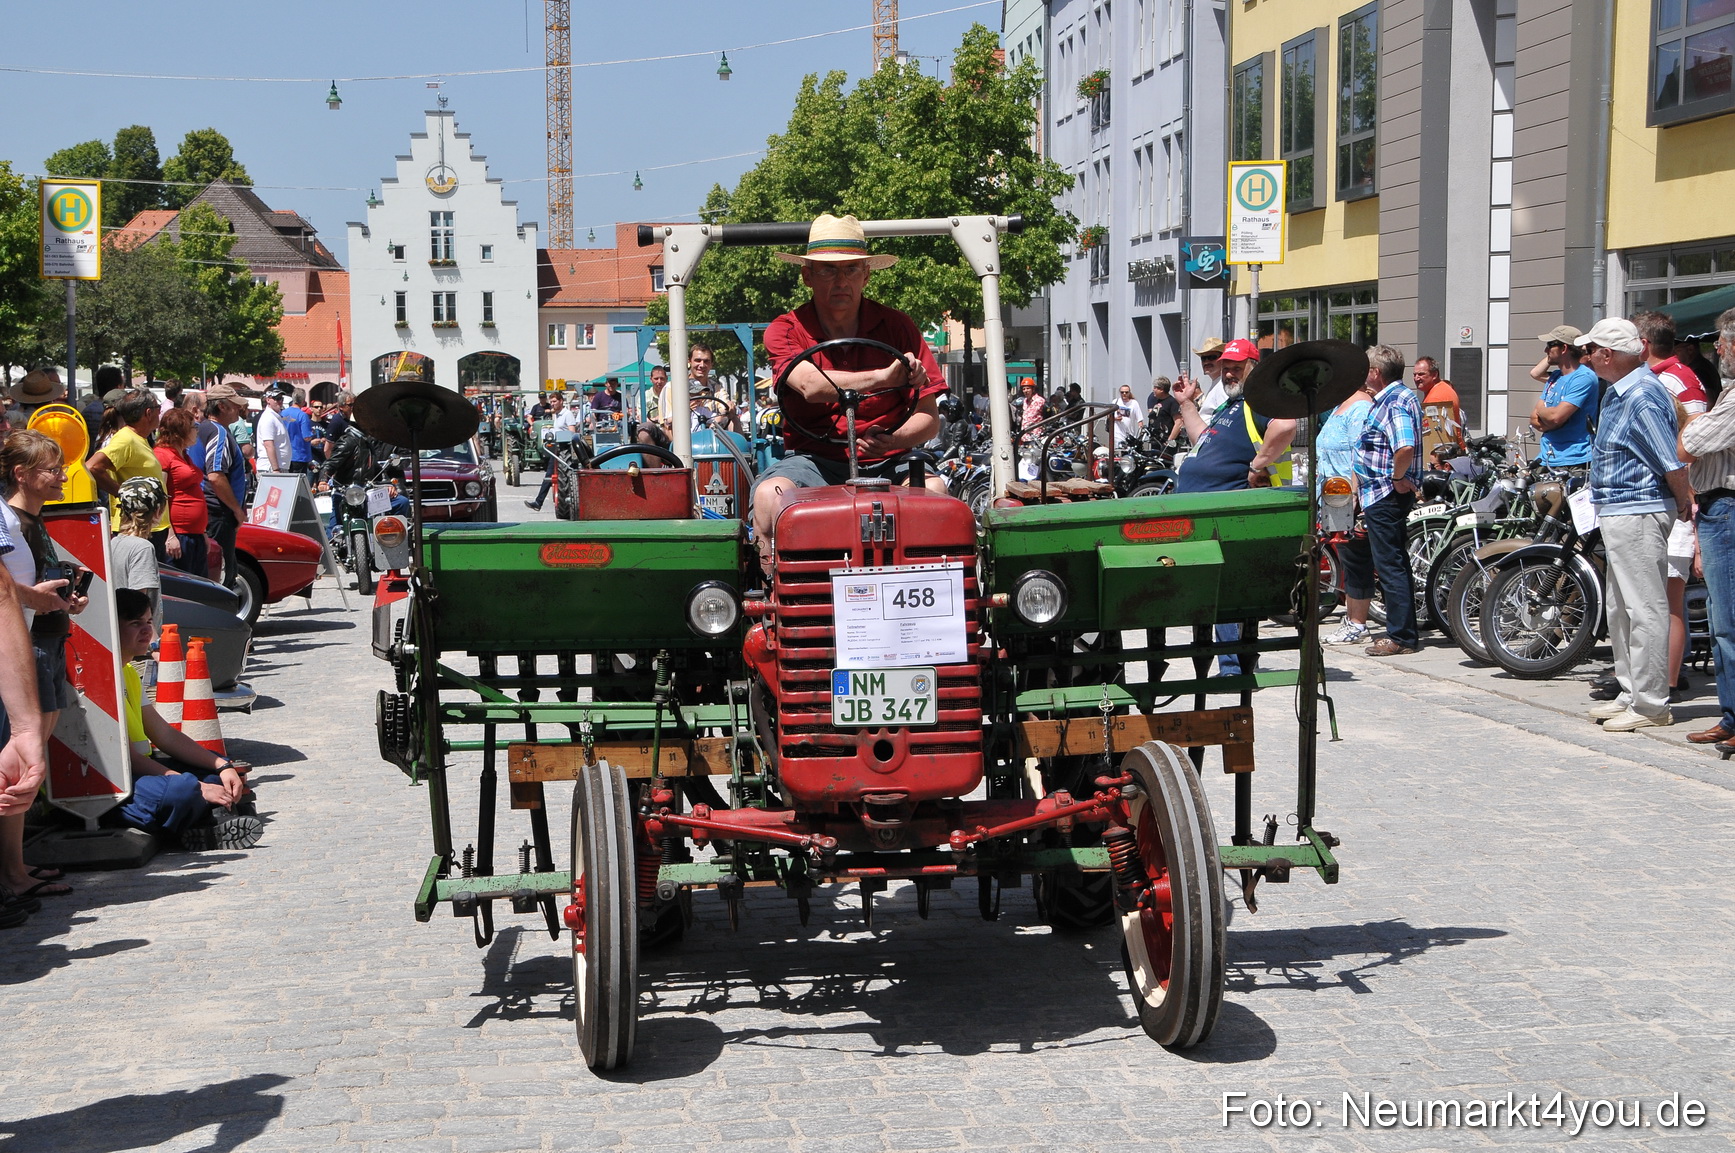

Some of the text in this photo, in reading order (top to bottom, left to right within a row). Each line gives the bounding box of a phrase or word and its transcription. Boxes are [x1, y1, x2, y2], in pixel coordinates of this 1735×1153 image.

[1198, 251, 1215, 272] G2
[1428, 505, 1442, 514] 102
[546, 544, 604, 560] Hassia
[892, 587, 935, 609] 458
[852, 672, 886, 696] NM
[841, 698, 928, 722] JB 347
[1116, 722, 1125, 730] 13
[669, 752, 676, 761] 11
[1033, 746, 1039, 754] 5
